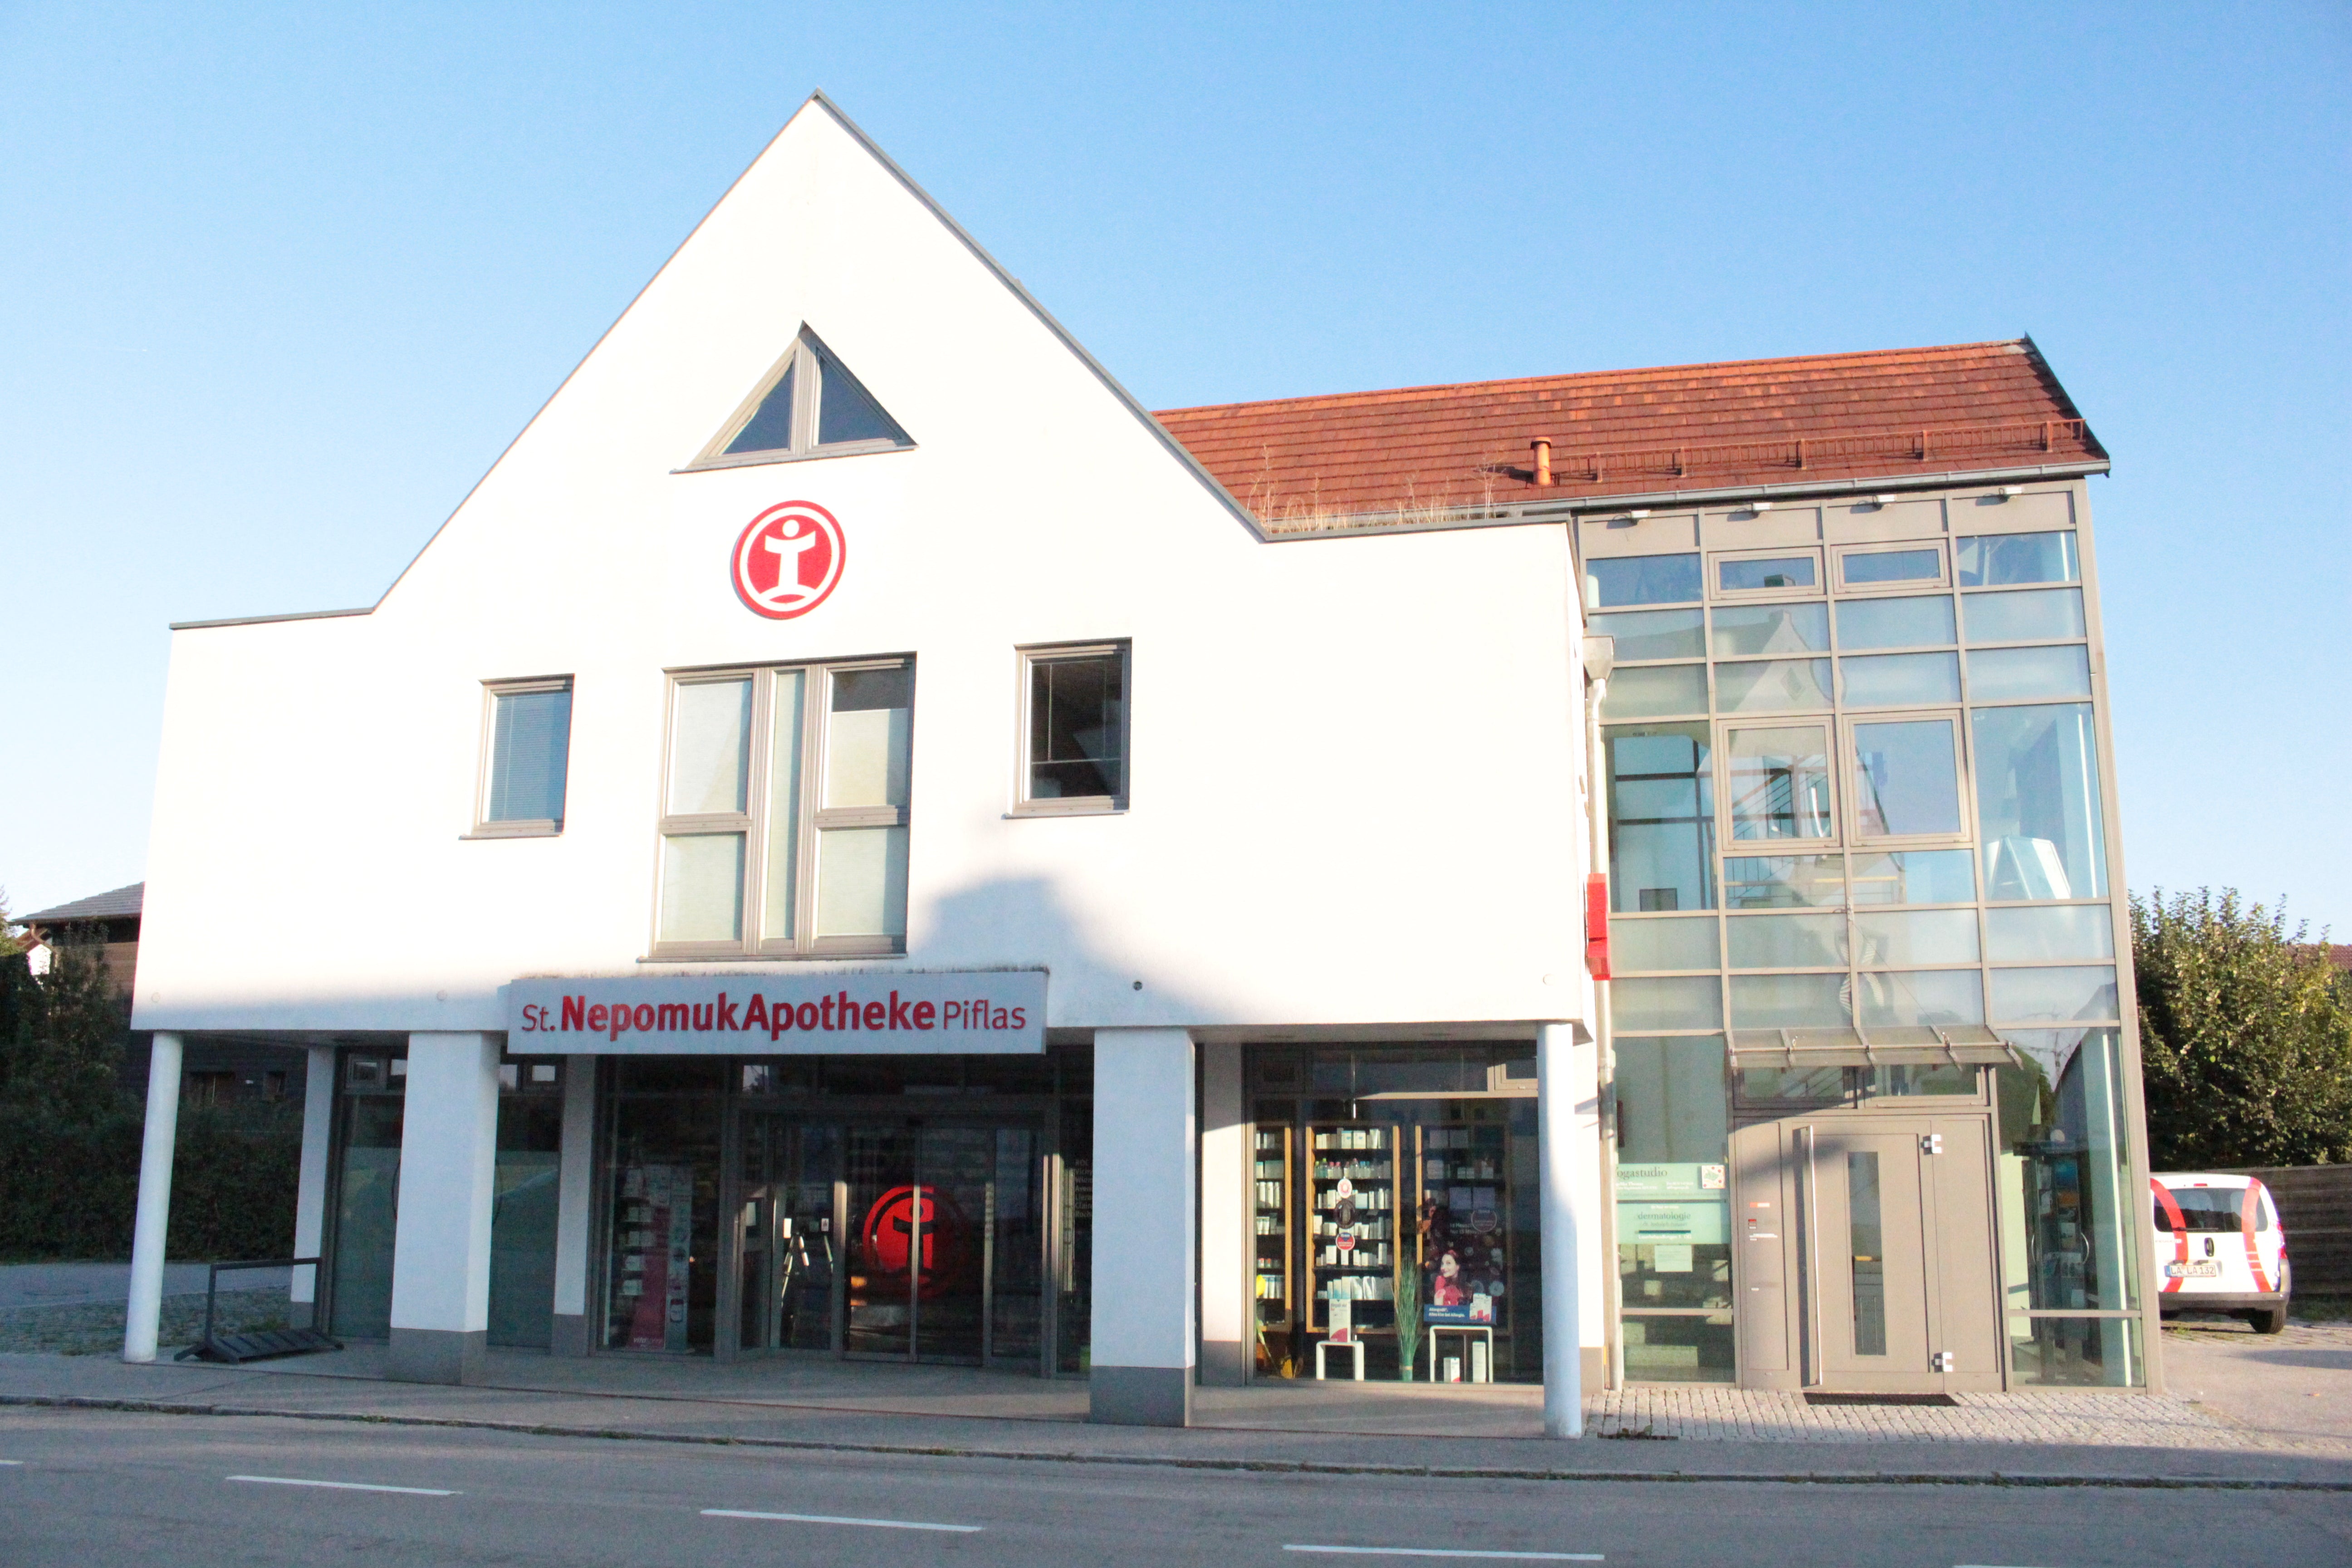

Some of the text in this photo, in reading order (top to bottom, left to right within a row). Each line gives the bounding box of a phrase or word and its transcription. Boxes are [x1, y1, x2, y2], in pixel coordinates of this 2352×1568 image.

[521, 1004, 556, 1032] St.
[943, 999, 1026, 1030] Piflas
[1616, 1166, 1668, 1181] ogastudio
[1638, 1212, 1691, 1221] dermatologie
[2200, 1266, 2215, 1274] 132
